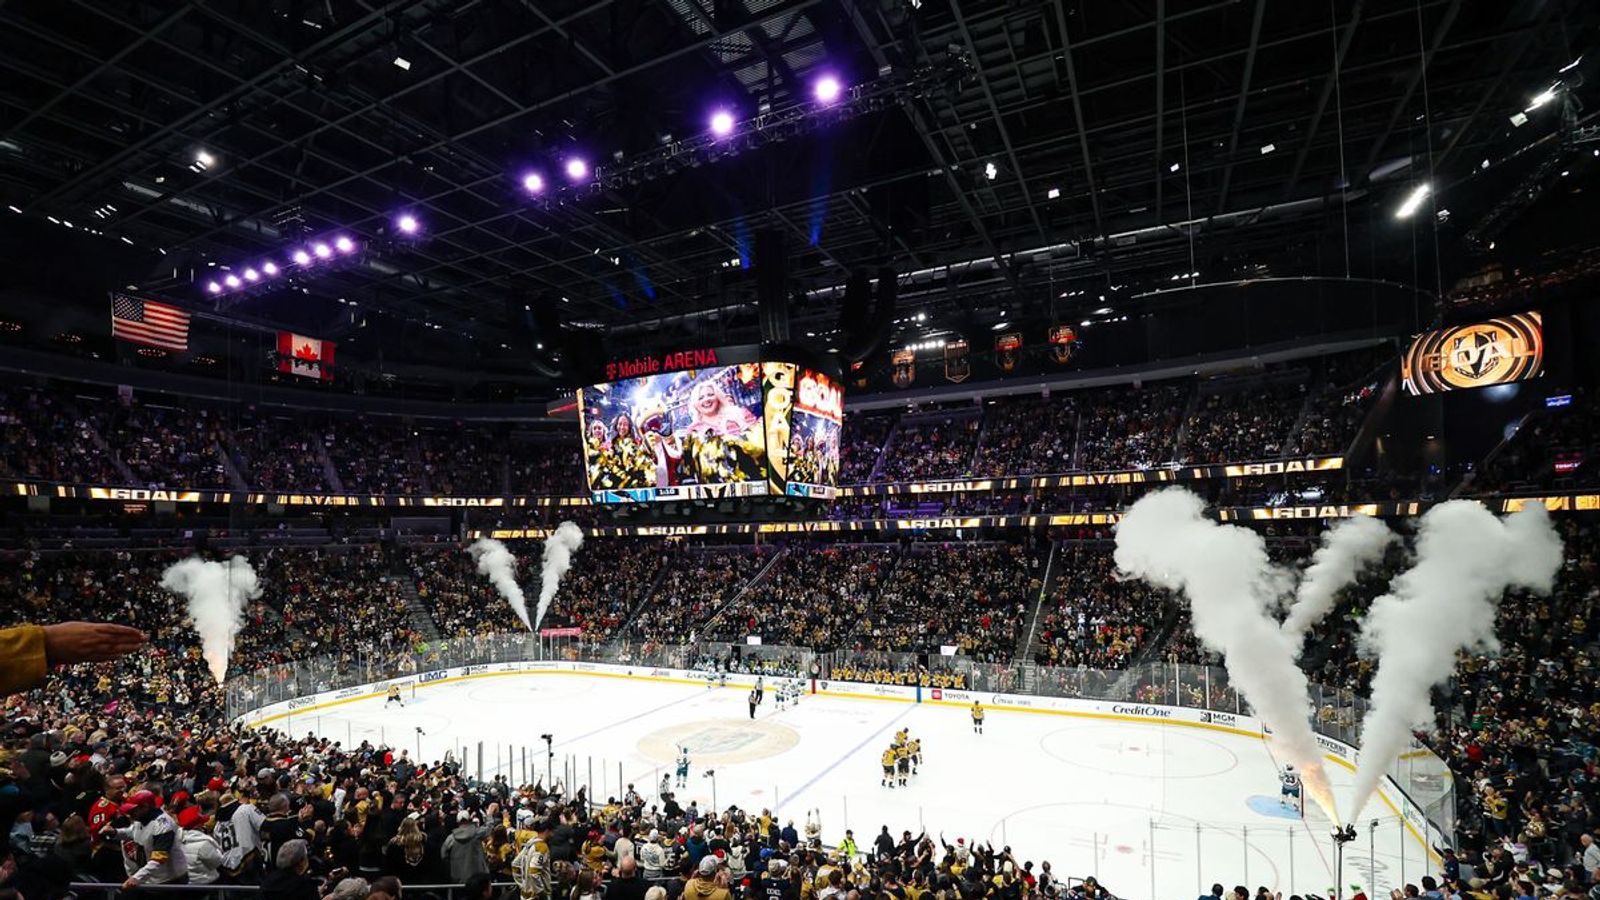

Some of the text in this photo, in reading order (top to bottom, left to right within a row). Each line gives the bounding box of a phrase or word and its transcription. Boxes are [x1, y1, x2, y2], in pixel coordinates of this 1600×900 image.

[663, 348, 718, 371] ARENA
[1243, 460, 1319, 475] GOAL
[923, 481, 975, 493] GOAL
[110, 488, 180, 501] GOAL
[437, 497, 489, 507] GOAL
[1272, 504, 1352, 520] GOAL
[910, 518, 963, 530] GOAL
[944, 691, 970, 700] TOYOTA
[1112, 704, 1171, 717] CreditOne
[1213, 713, 1236, 723] MGM
[221, 824, 240, 852] 61
